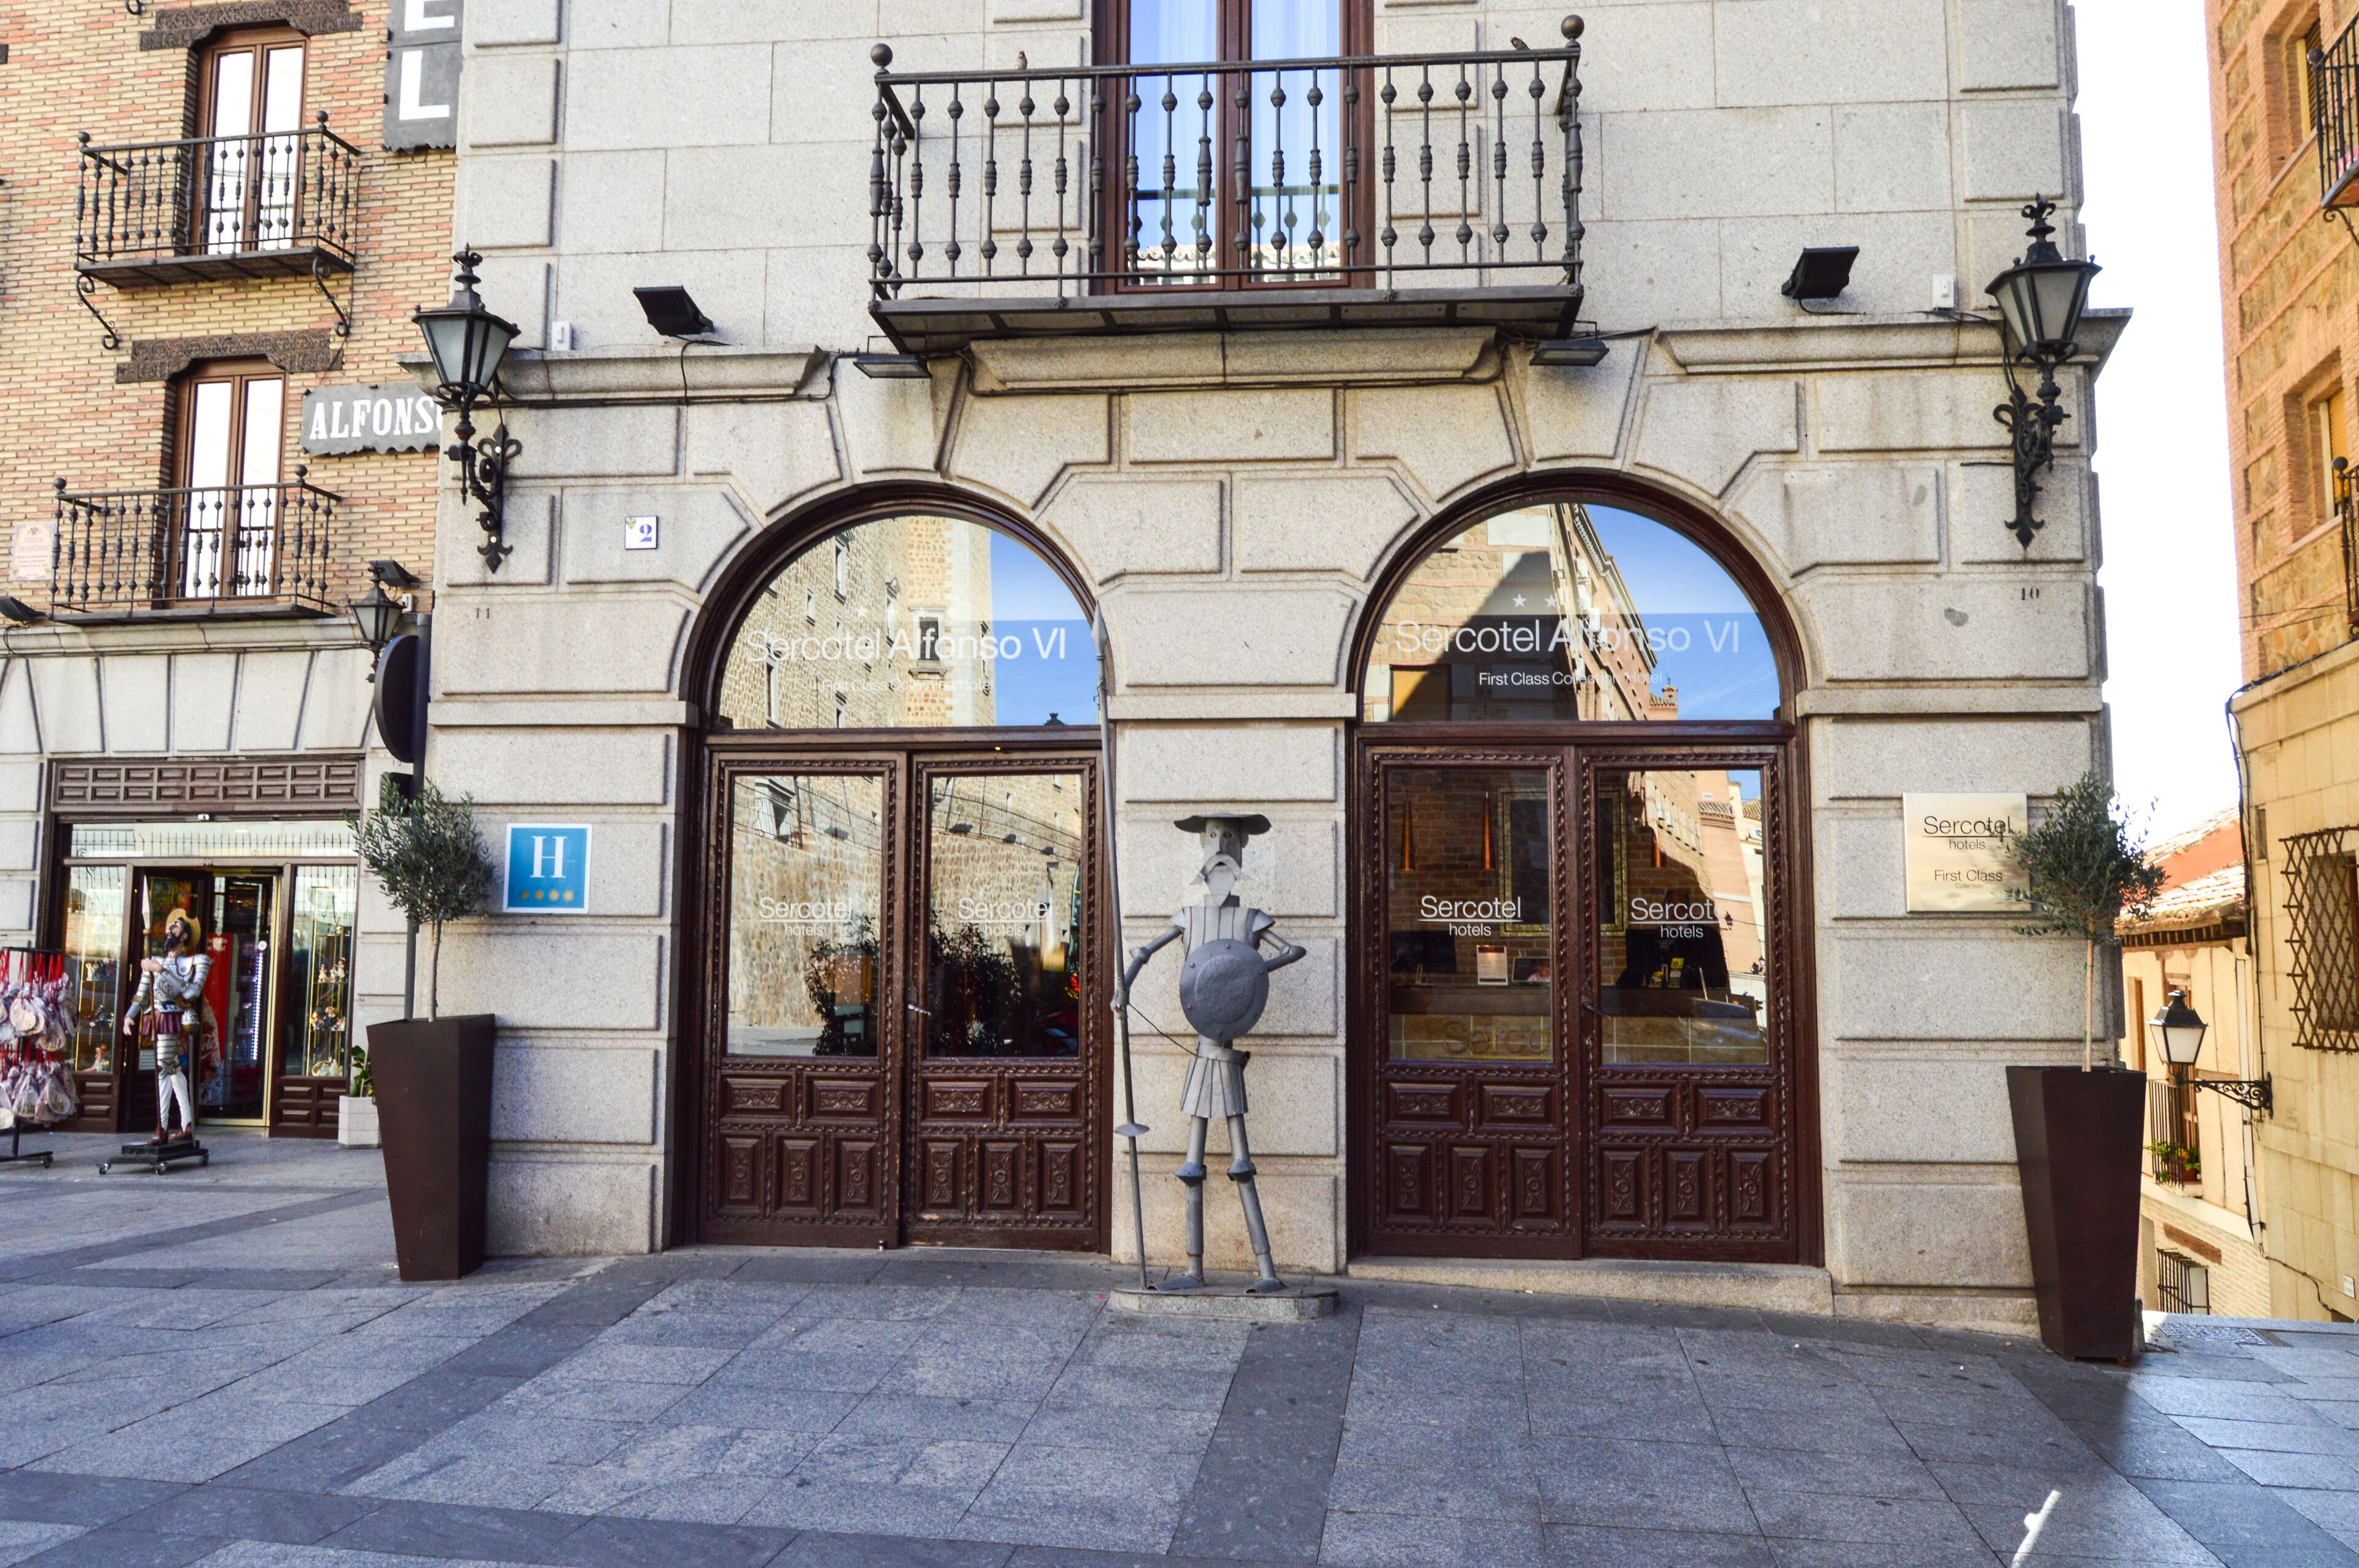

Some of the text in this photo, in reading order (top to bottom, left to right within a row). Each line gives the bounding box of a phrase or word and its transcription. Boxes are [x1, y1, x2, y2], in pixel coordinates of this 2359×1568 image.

[309, 396, 443, 440] ALFONS
[640, 524, 652, 542] 2
[2021, 587, 2040, 601] 10
[746, 627, 1066, 661] Sercotel Alfonso VI
[1396, 617, 1739, 653] Sercotel Alfonso VI
[1479, 673, 1508, 685] First
[1511, 672, 1549, 685] Class
[1552, 672, 1622, 685] Collection
[1923, 816, 2011, 835] Sercotel
[1949, 839, 1985, 850] hotels
[530, 836, 568, 878] H
[1935, 870, 2003, 882] First Class
[759, 897, 852, 919] Sercotel
[958, 897, 1053, 919] Sercotel
[1420, 895, 1521, 918] Sercotel
[1631, 897, 1732, 920] Sercot
[784, 923, 824, 936] hotels
[985, 923, 1025, 937] hotels
[1449, 922, 1492, 936] hotels
[1661, 925, 1704, 938] hotels
